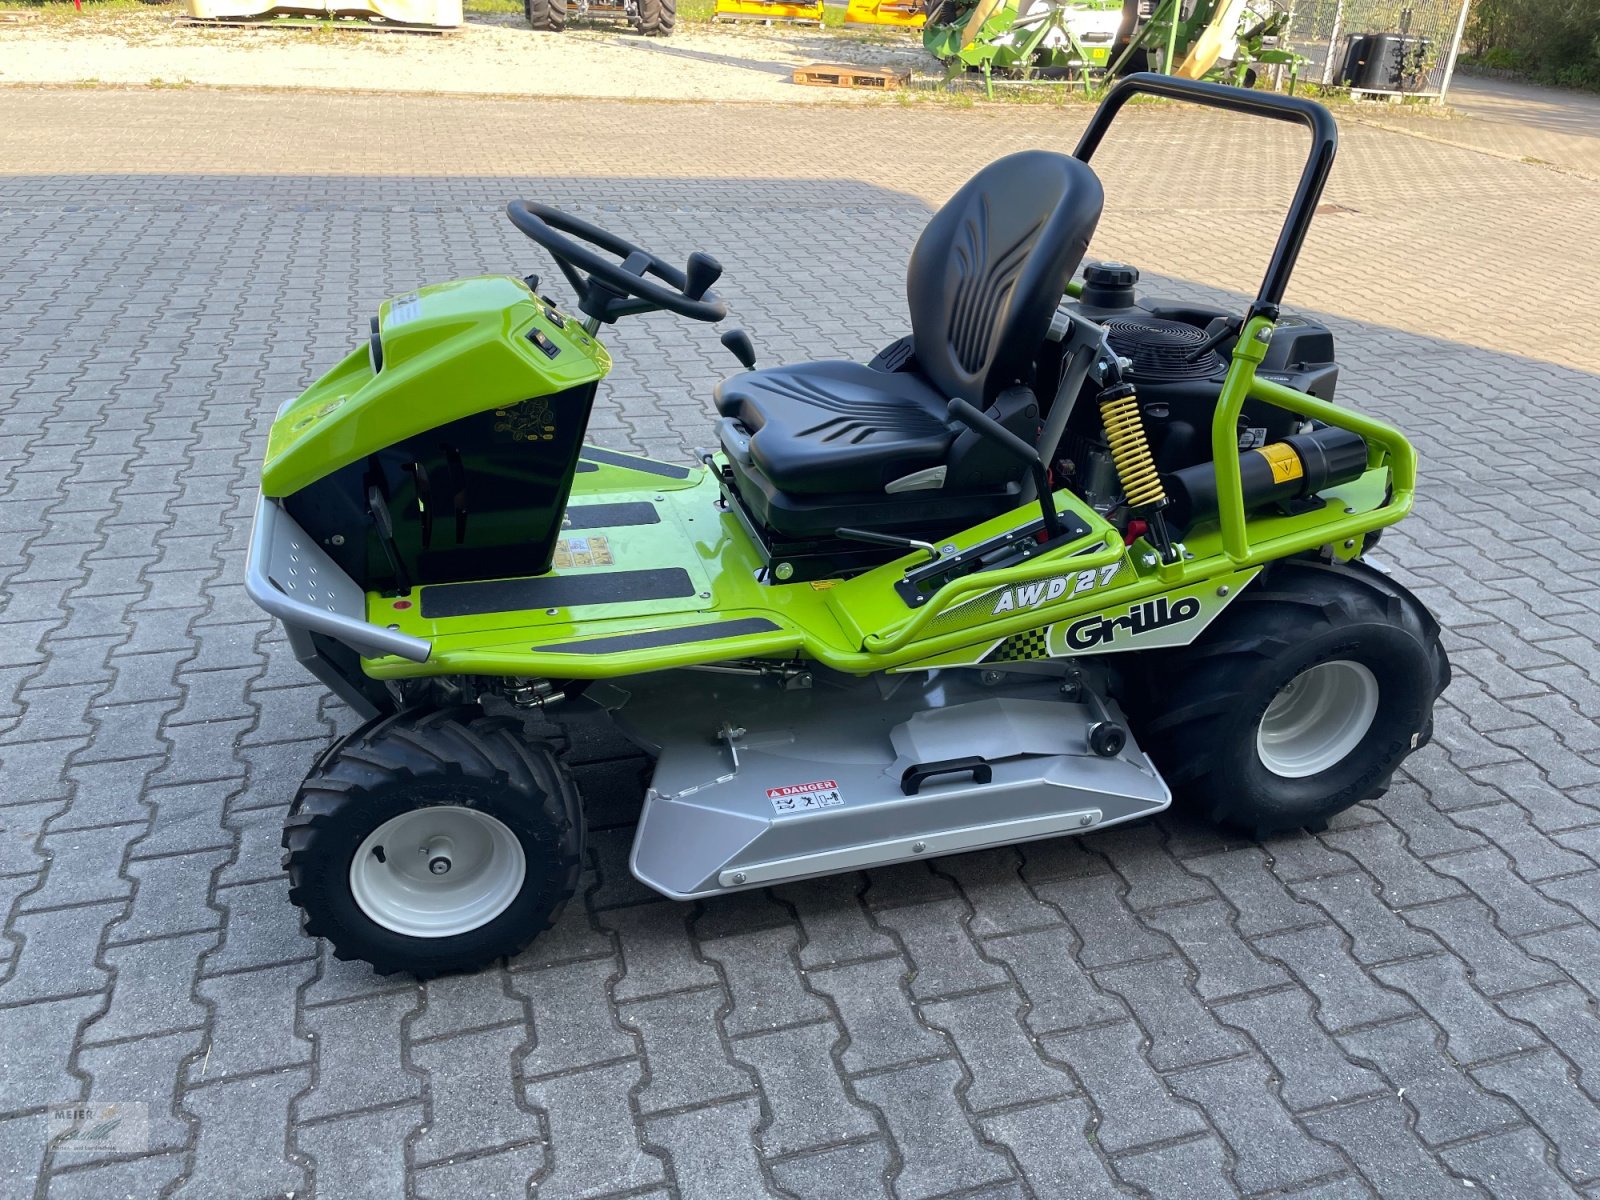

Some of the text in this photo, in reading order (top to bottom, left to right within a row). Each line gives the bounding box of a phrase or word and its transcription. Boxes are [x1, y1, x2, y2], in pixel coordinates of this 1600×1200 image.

[992, 563, 1121, 615] AWD 27
[1065, 596, 1201, 651] Grillo
[782, 781, 834, 795] DANGER
